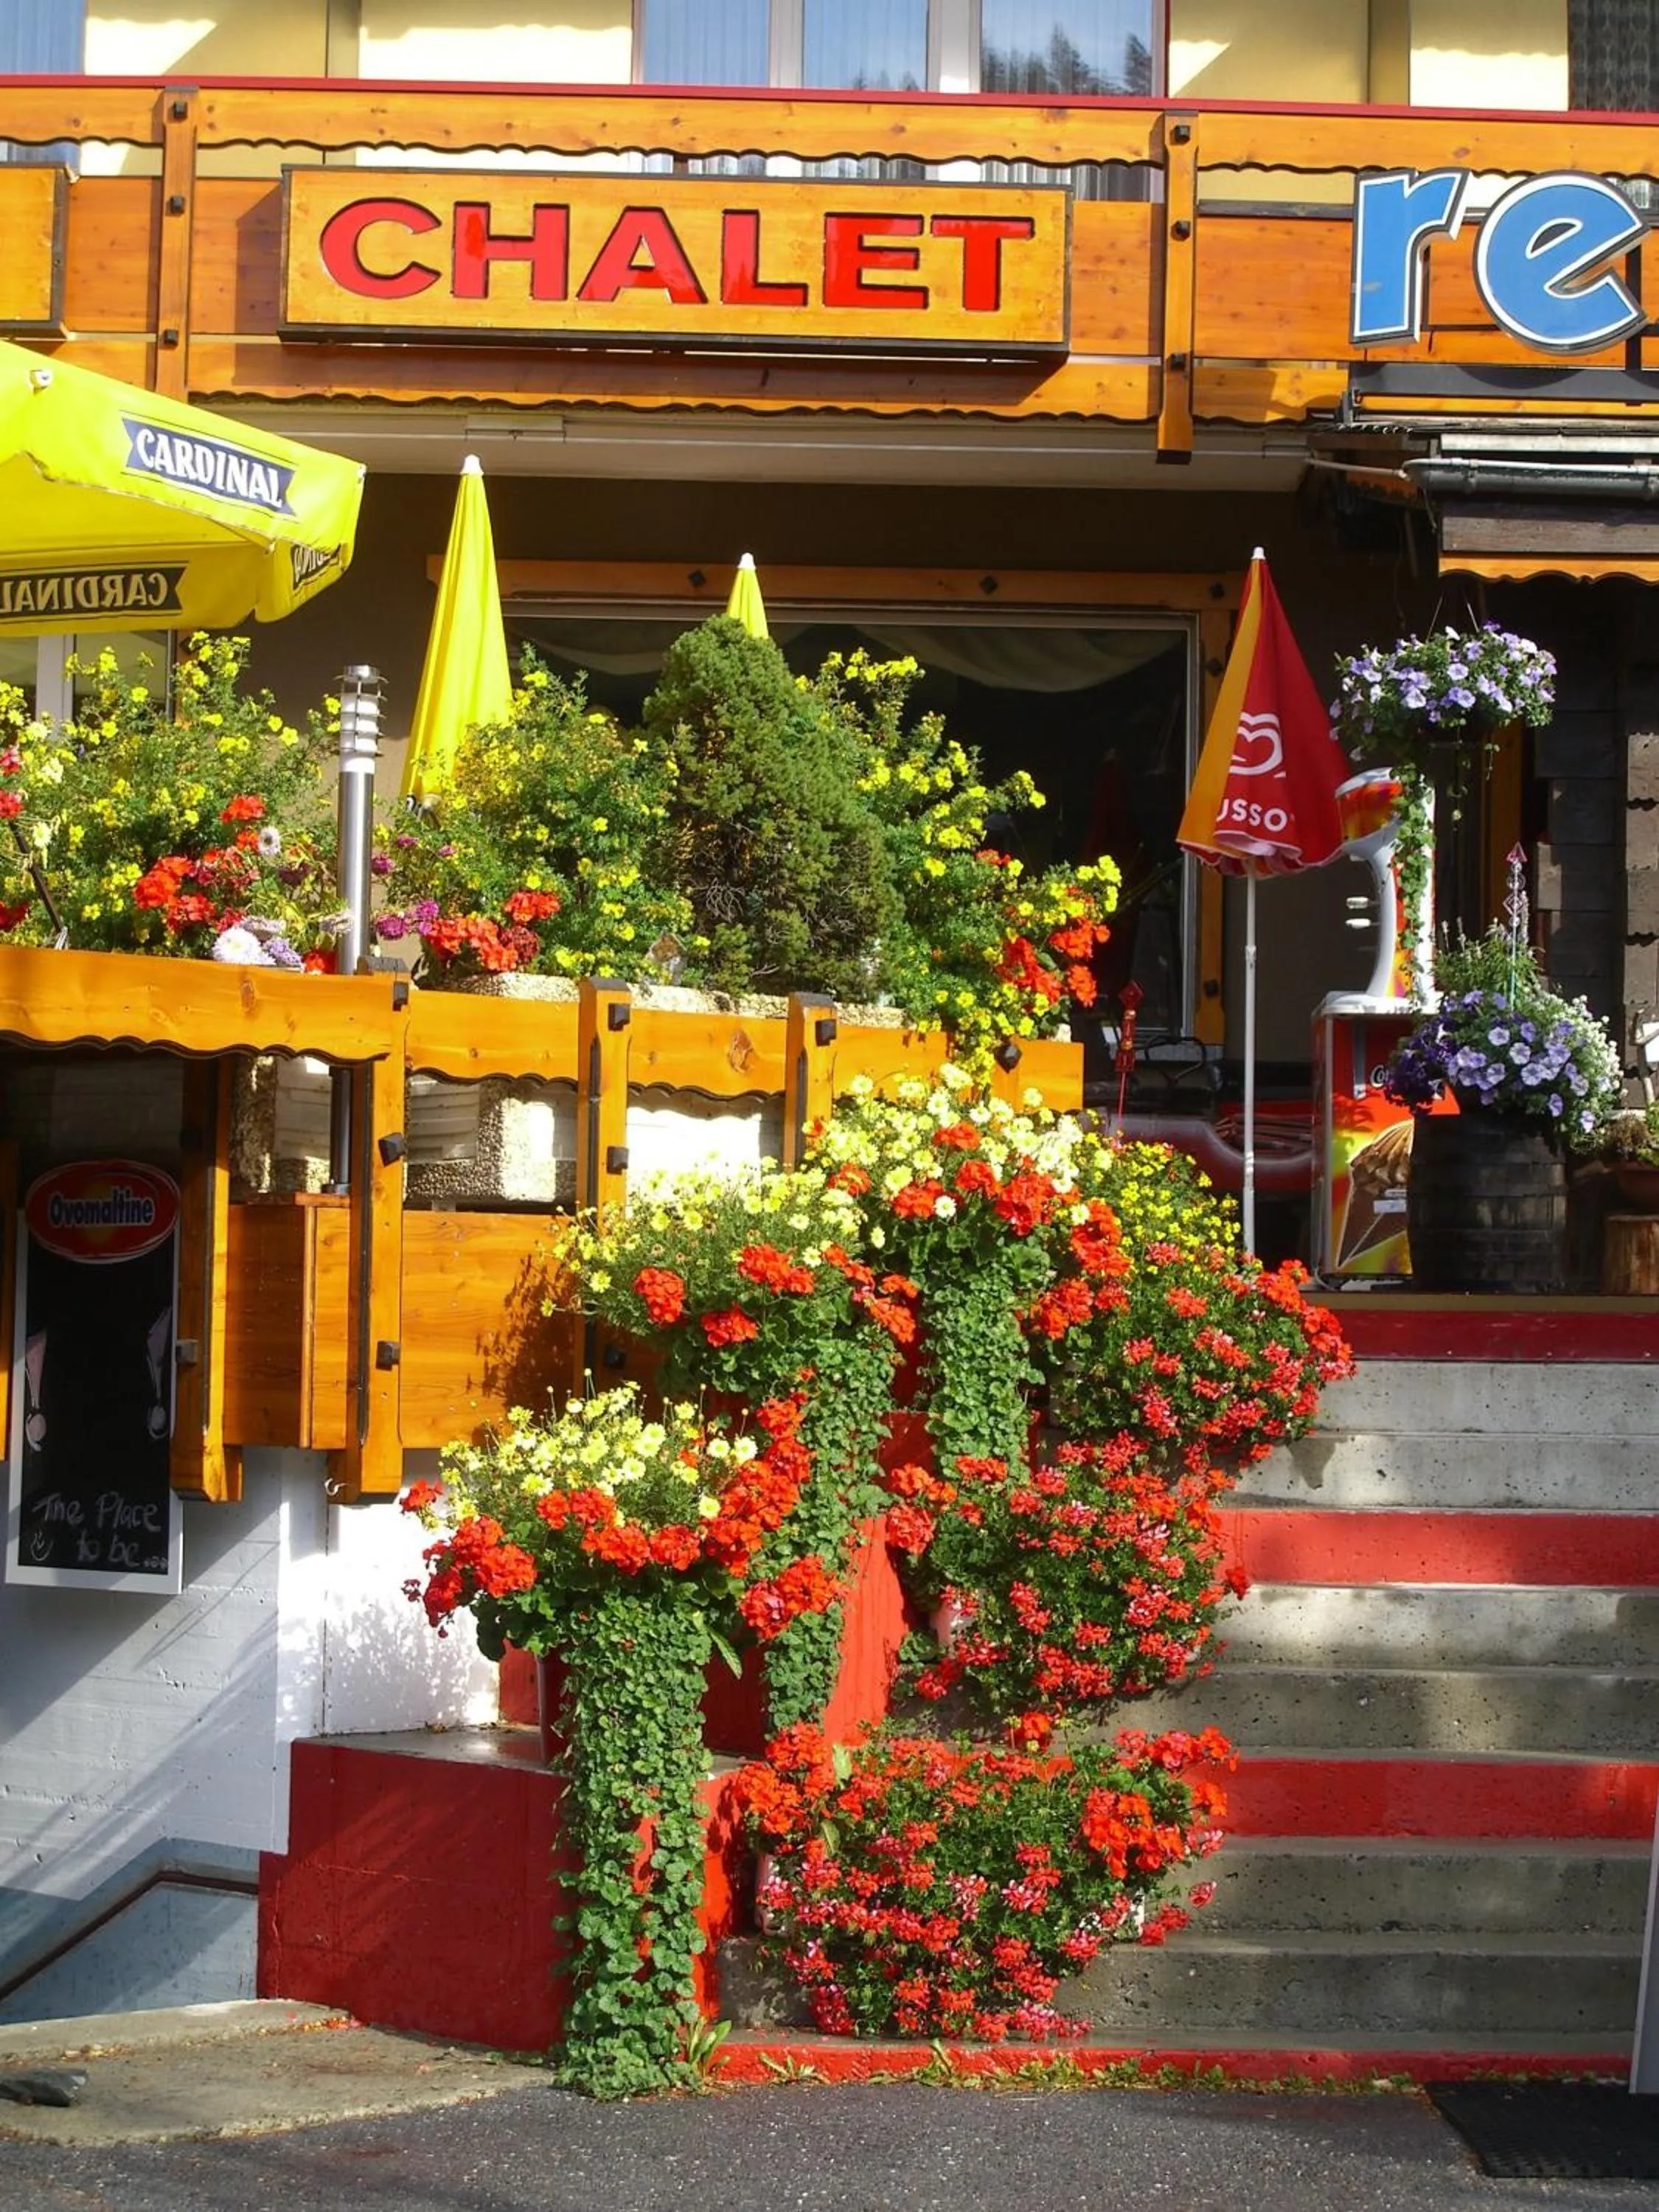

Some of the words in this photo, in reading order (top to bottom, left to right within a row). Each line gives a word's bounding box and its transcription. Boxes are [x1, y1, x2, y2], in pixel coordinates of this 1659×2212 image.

[319, 197, 1034, 311] CHALET
[1349, 167, 1650, 355] re
[136, 428, 283, 509] CARDINAL
[49, 1185, 156, 1227] Ovomaltine
[32, 1492, 86, 1526] The
[96, 1490, 162, 1532] Place
[76, 1528, 100, 1562] to
